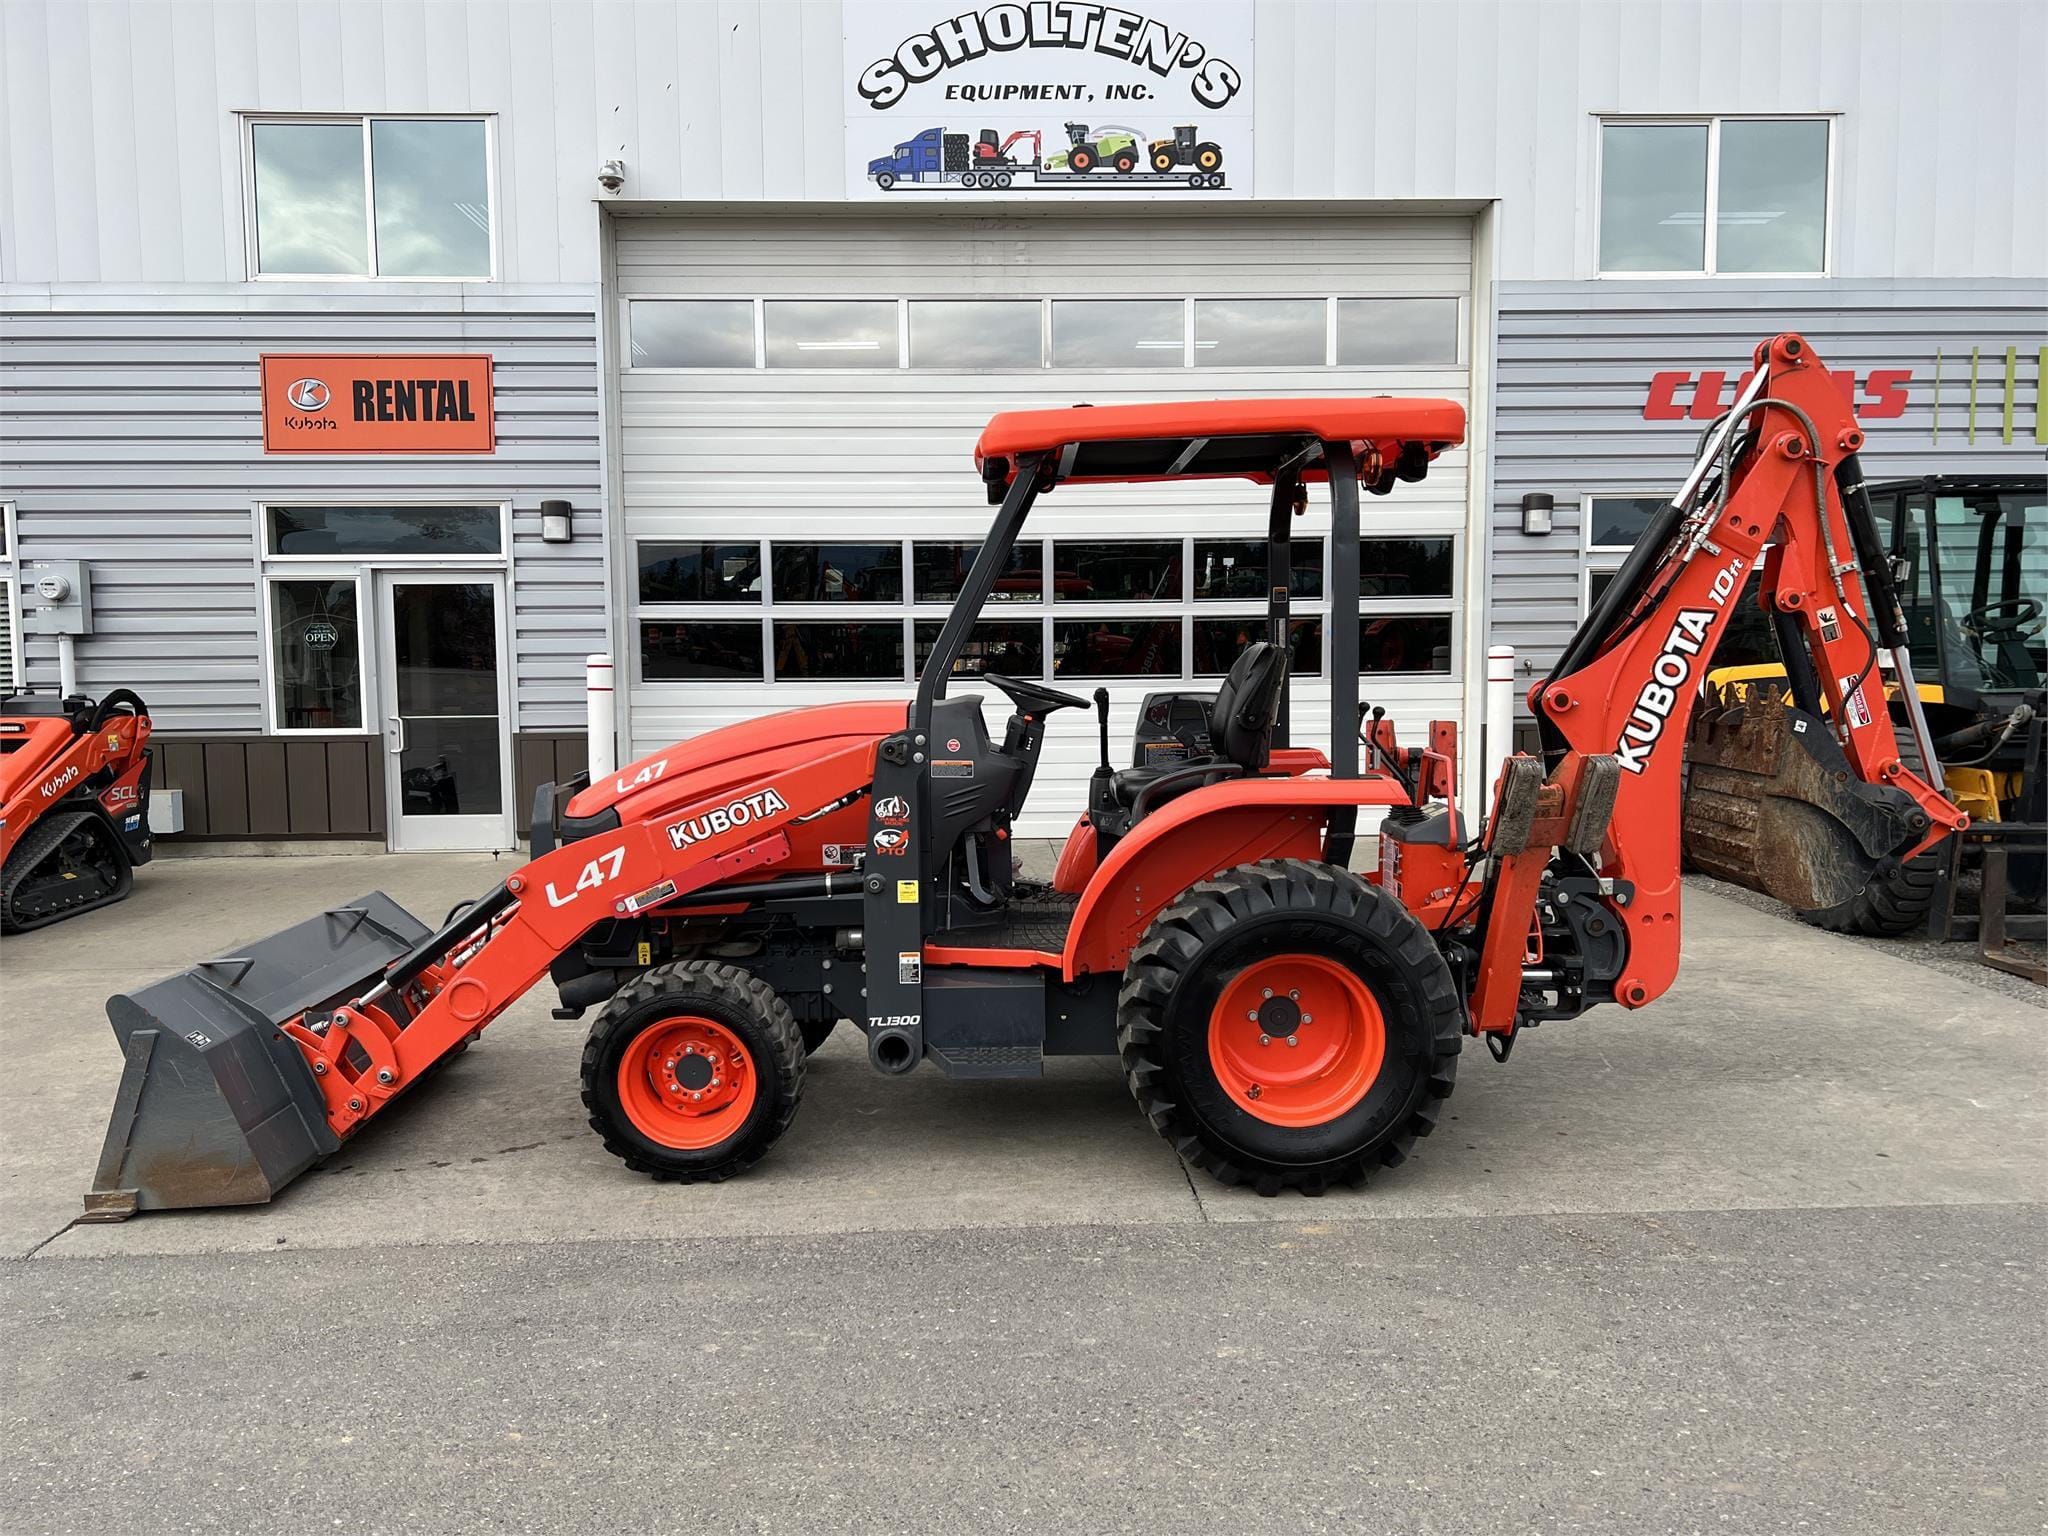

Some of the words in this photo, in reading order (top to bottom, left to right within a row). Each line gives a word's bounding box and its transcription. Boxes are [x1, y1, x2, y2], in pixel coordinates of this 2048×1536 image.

[857, 1, 1242, 110] SCHOLTEN'S
[944, 83, 1095, 103] EQUIPMENT,
[1105, 83, 1155, 101] INC.
[352, 380, 476, 422] RENTAL
[285, 416, 337, 430] Kubota
[305, 632, 336, 642] OPEN
[1616, 609, 1718, 774] KUBOTA
[41, 765, 79, 798] Kubota
[111, 786, 137, 801] SCL
[616, 759, 668, 794] L47
[668, 788, 787, 851] KUBOTA
[876, 847, 905, 856] PTO
[545, 846, 626, 908] L47
[1288, 922, 1391, 968] TRAC
[868, 1015, 921, 1028] TL1300
